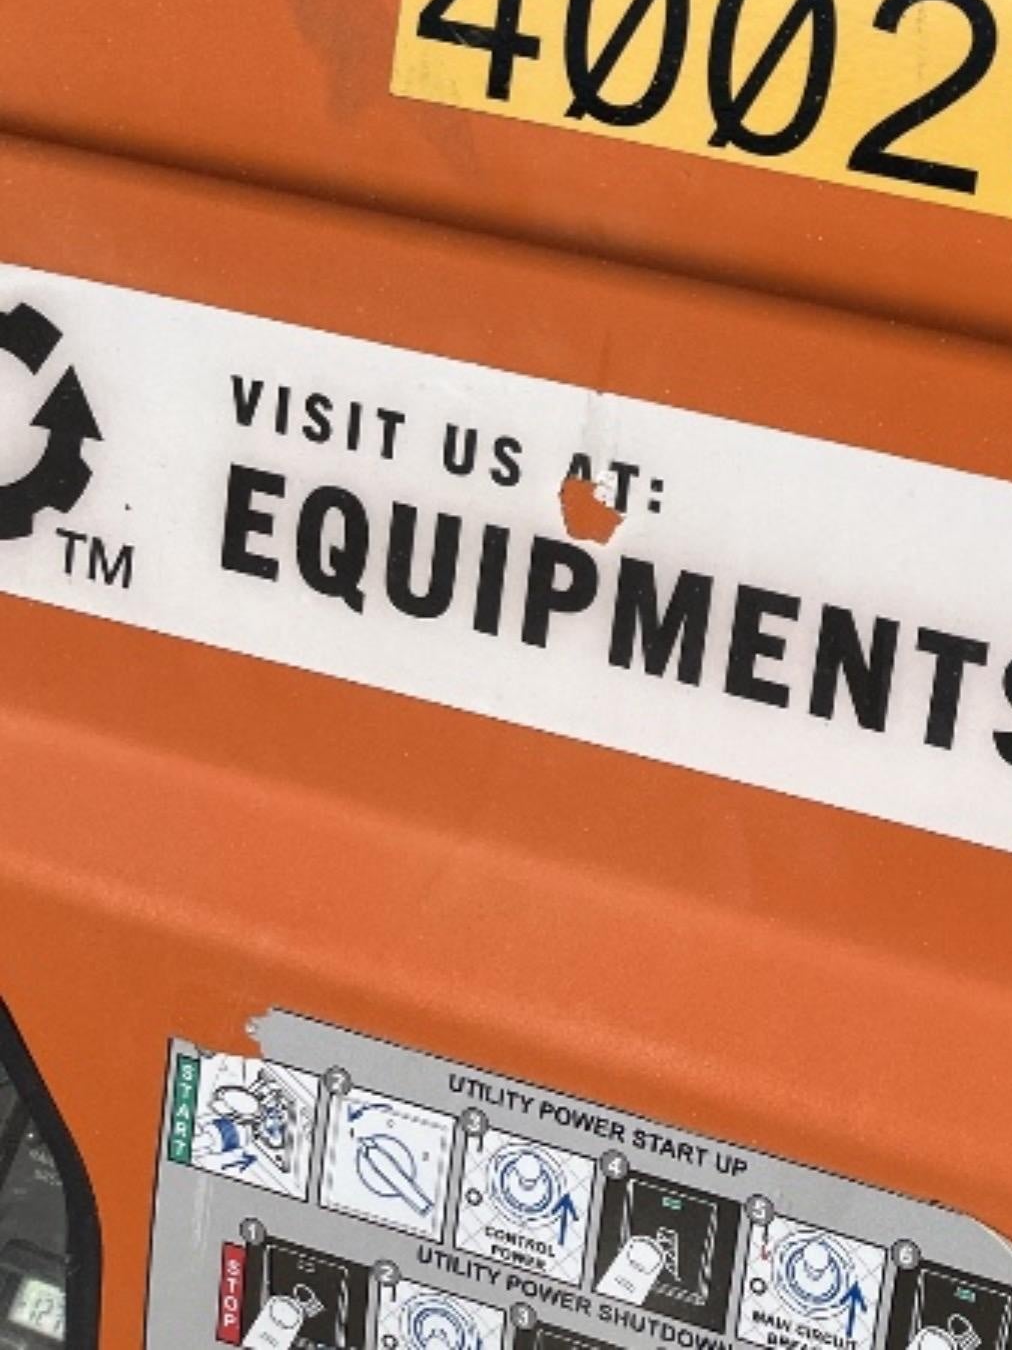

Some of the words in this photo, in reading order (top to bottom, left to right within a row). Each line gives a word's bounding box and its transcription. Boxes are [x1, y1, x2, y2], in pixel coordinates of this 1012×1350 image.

[230, 375, 406, 460] VISIT
[443, 423, 523, 487] US
[56, 527, 134, 589] TM
[174, 1064, 193, 1156] START
[449, 1073, 534, 1114] UTILITY
[539, 1100, 626, 1144] POWER
[632, 1130, 707, 1167] START
[715, 1152, 748, 1177] UP
[484, 1225, 555, 1257] CONTROL
[223, 1259, 240, 1327] STOP
[417, 1248, 501, 1286] UTILITY
[505, 1274, 593, 1318] POWER
